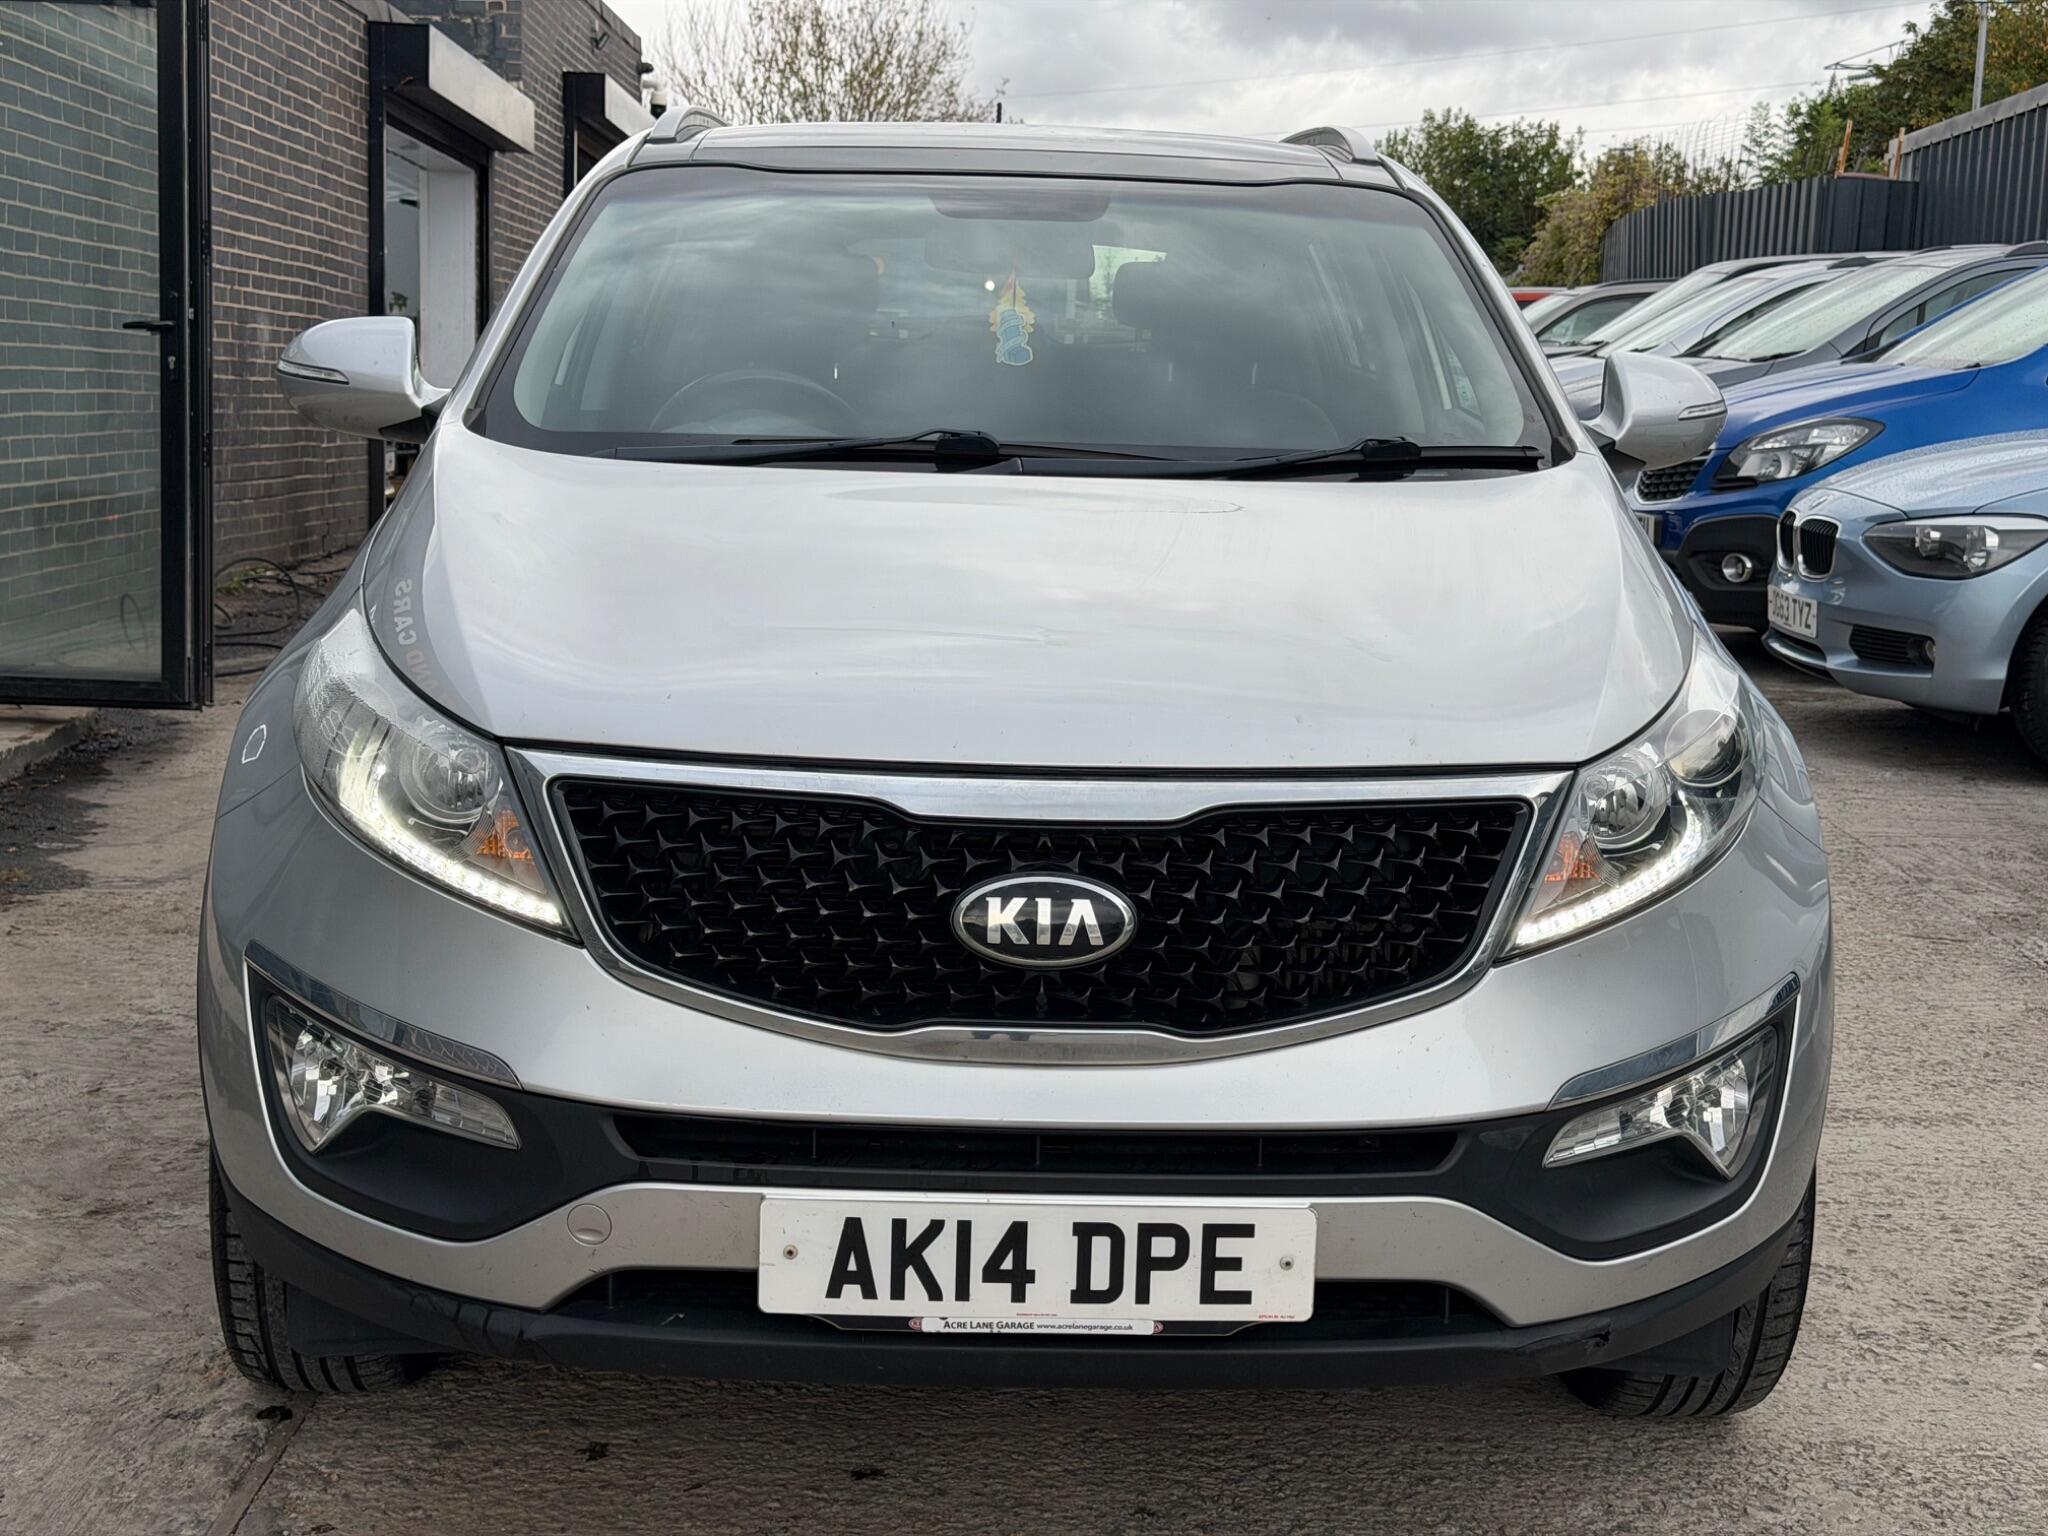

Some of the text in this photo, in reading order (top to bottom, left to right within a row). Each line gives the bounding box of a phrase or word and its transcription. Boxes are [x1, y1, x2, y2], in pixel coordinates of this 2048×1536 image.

[1791, 598, 1812, 629] TYZ
[985, 896, 1104, 946] KIA
[825, 1216, 1256, 1305] AK14 DPE
[943, 1320, 1134, 1332] ACRE LANE GARAGE www.acrelanegarage.co.uk
